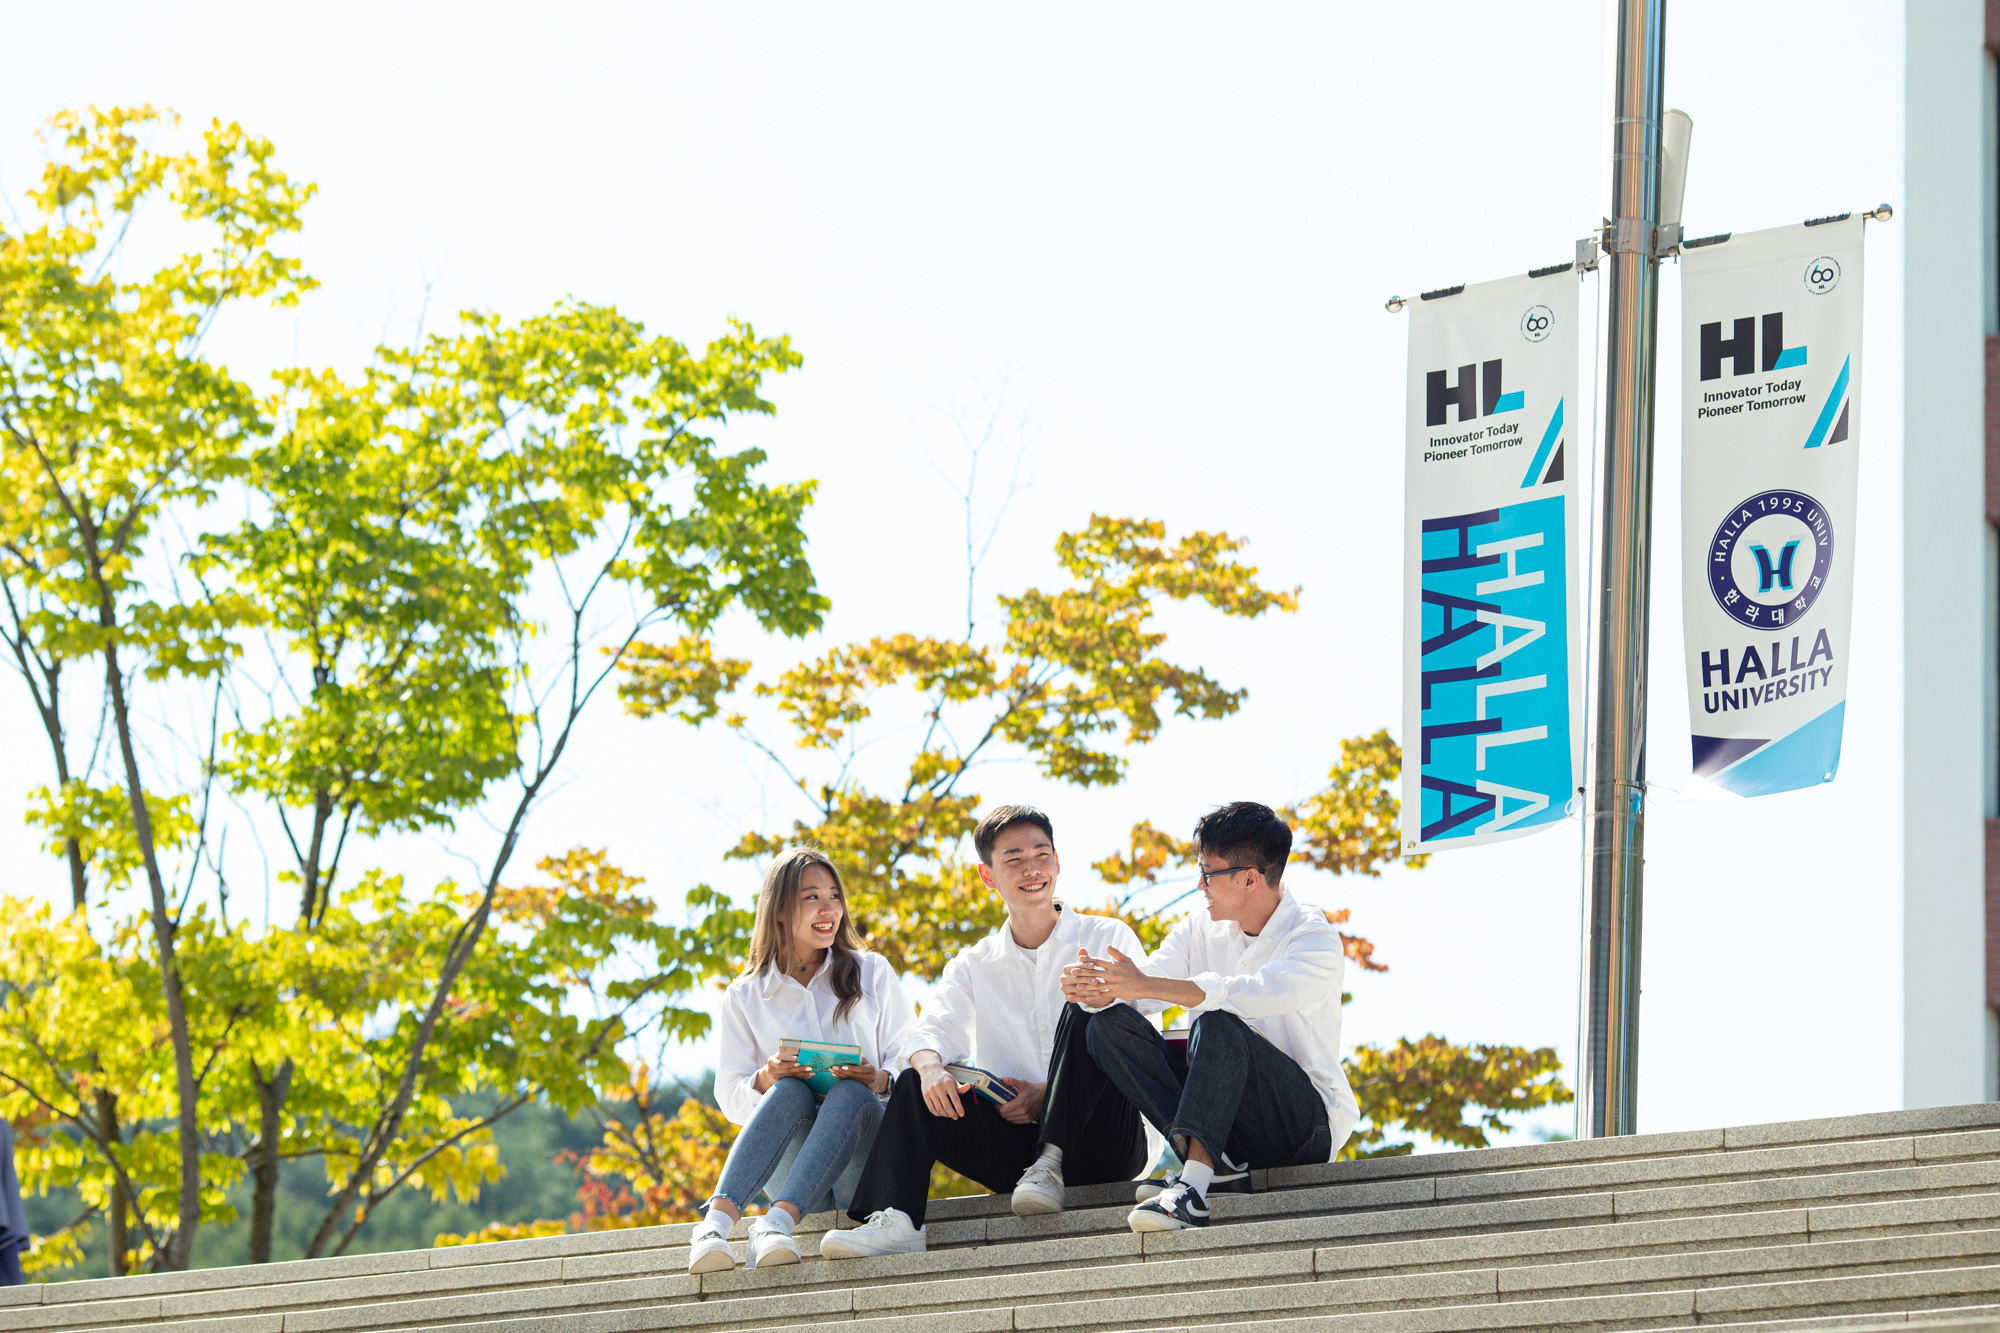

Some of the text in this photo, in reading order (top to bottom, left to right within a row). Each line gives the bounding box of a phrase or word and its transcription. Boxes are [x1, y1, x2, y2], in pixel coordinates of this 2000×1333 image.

[1811, 265, 1834, 284] 60
[1527, 313, 1549, 332] 60
[1700, 311, 1807, 382] HL
[1426, 358, 1525, 427] HL
[1698, 393, 1806, 419] Pioneer Tomorrow
[1704, 379, 1802, 403] Innovator Today
[1424, 436, 1523, 463] Pioneer Tomorrow
[1429, 423, 1519, 448] Innovator Today
[1714, 497, 1828, 562] HALLA 1995 UNIV
[1723, 575, 1822, 625] 한라대학교
[1421, 508, 1502, 843] HALLA
[1701, 628, 1834, 688] HALLA
[1474, 532, 1550, 836] HALLA
[1704, 664, 1834, 714] UNIVERSITY
